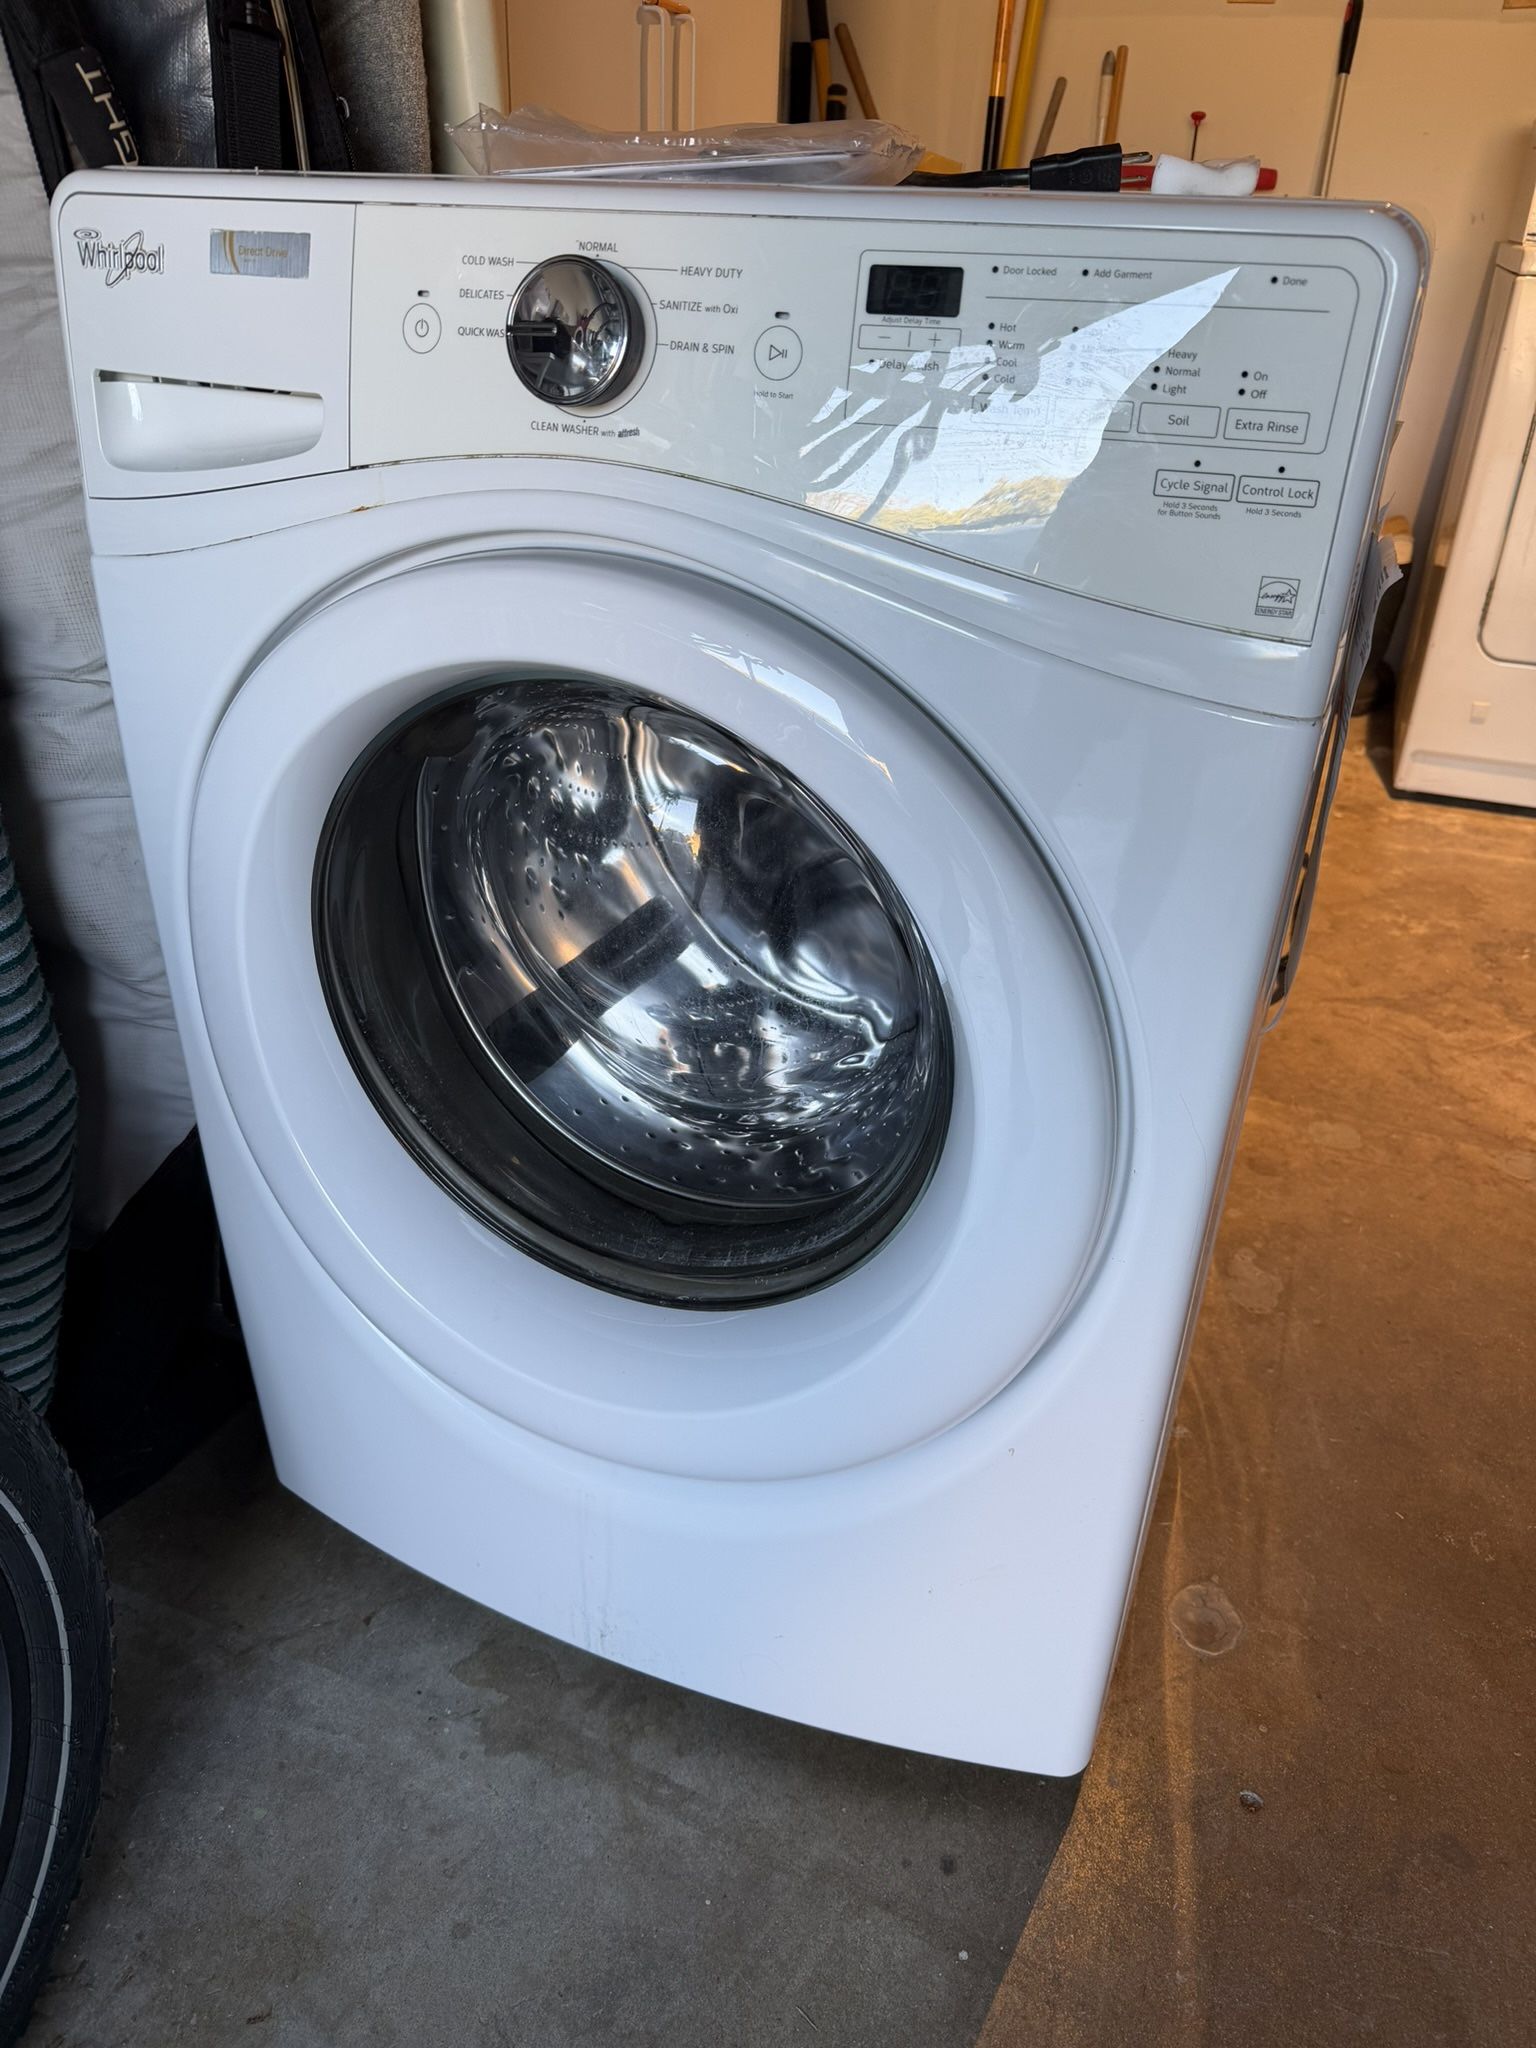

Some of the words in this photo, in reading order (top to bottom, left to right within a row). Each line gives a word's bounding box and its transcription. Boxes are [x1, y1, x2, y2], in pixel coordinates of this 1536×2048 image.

[577, 240, 618, 253] NORMAL
[76, 240, 165, 281] Whirlpool
[461, 254, 486, 266] COLD
[488, 256, 515, 267] WASH
[680, 266, 712, 279] HEAVY
[714, 267, 744, 280] DUTY
[1002, 266, 1025, 276] Door
[1026, 267, 1057, 277] Locked
[1094, 269, 1112, 279] Add
[1114, 270, 1152, 280] Garment
[1282, 276, 1308, 287] Done
[459, 288, 505, 300] DELICATES
[658, 299, 703, 313] SANITIZE
[704, 304, 721, 314] with
[723, 303, 739, 315] Oxi
[881, 315, 902, 326] Adjust
[903, 316, 922, 326] Delay
[923, 317, 941, 326] Time
[457, 326, 484, 338] QUICK
[484, 327, 505, 338] WAS
[999, 322, 1017, 333] Hot
[669, 339, 700, 353] DRAIN
[702, 342, 710, 353] &
[712, 342, 735, 355] SPIN
[998, 340, 1025, 350] Warm
[1167, 350, 1198, 361] Heavy
[995, 357, 1018, 368] Cool
[1164, 366, 1201, 378] Normal
[1253, 371, 1269, 382] On
[993, 374, 1016, 384] Cold
[778, 391, 795, 400] Start
[1162, 384, 1187, 396] Light
[1250, 389, 1267, 400] Off
[1167, 414, 1190, 426] Soil
[530, 420, 560, 434] CLEAN
[560, 422, 600, 436] WASHER
[601, 428, 616, 438] with
[1234, 419, 1264, 432] Extra
[1266, 420, 1299, 434] Rinse
[1160, 478, 1190, 492] Cycle
[1192, 479, 1229, 495] Signal
[1241, 484, 1285, 498] Control
[1287, 488, 1315, 501] Lock
[1162, 501, 1180, 510] Hold
[1181, 501, 1187, 510] 3
[1187, 502, 1218, 512] Seconds
[1157, 508, 1168, 517] for
[1169, 509, 1193, 519] Button
[1194, 511, 1221, 521] Sounds
[1245, 507, 1264, 516] Hold
[1264, 508, 1270, 517] 3
[1271, 509, 1302, 519] Seconds
